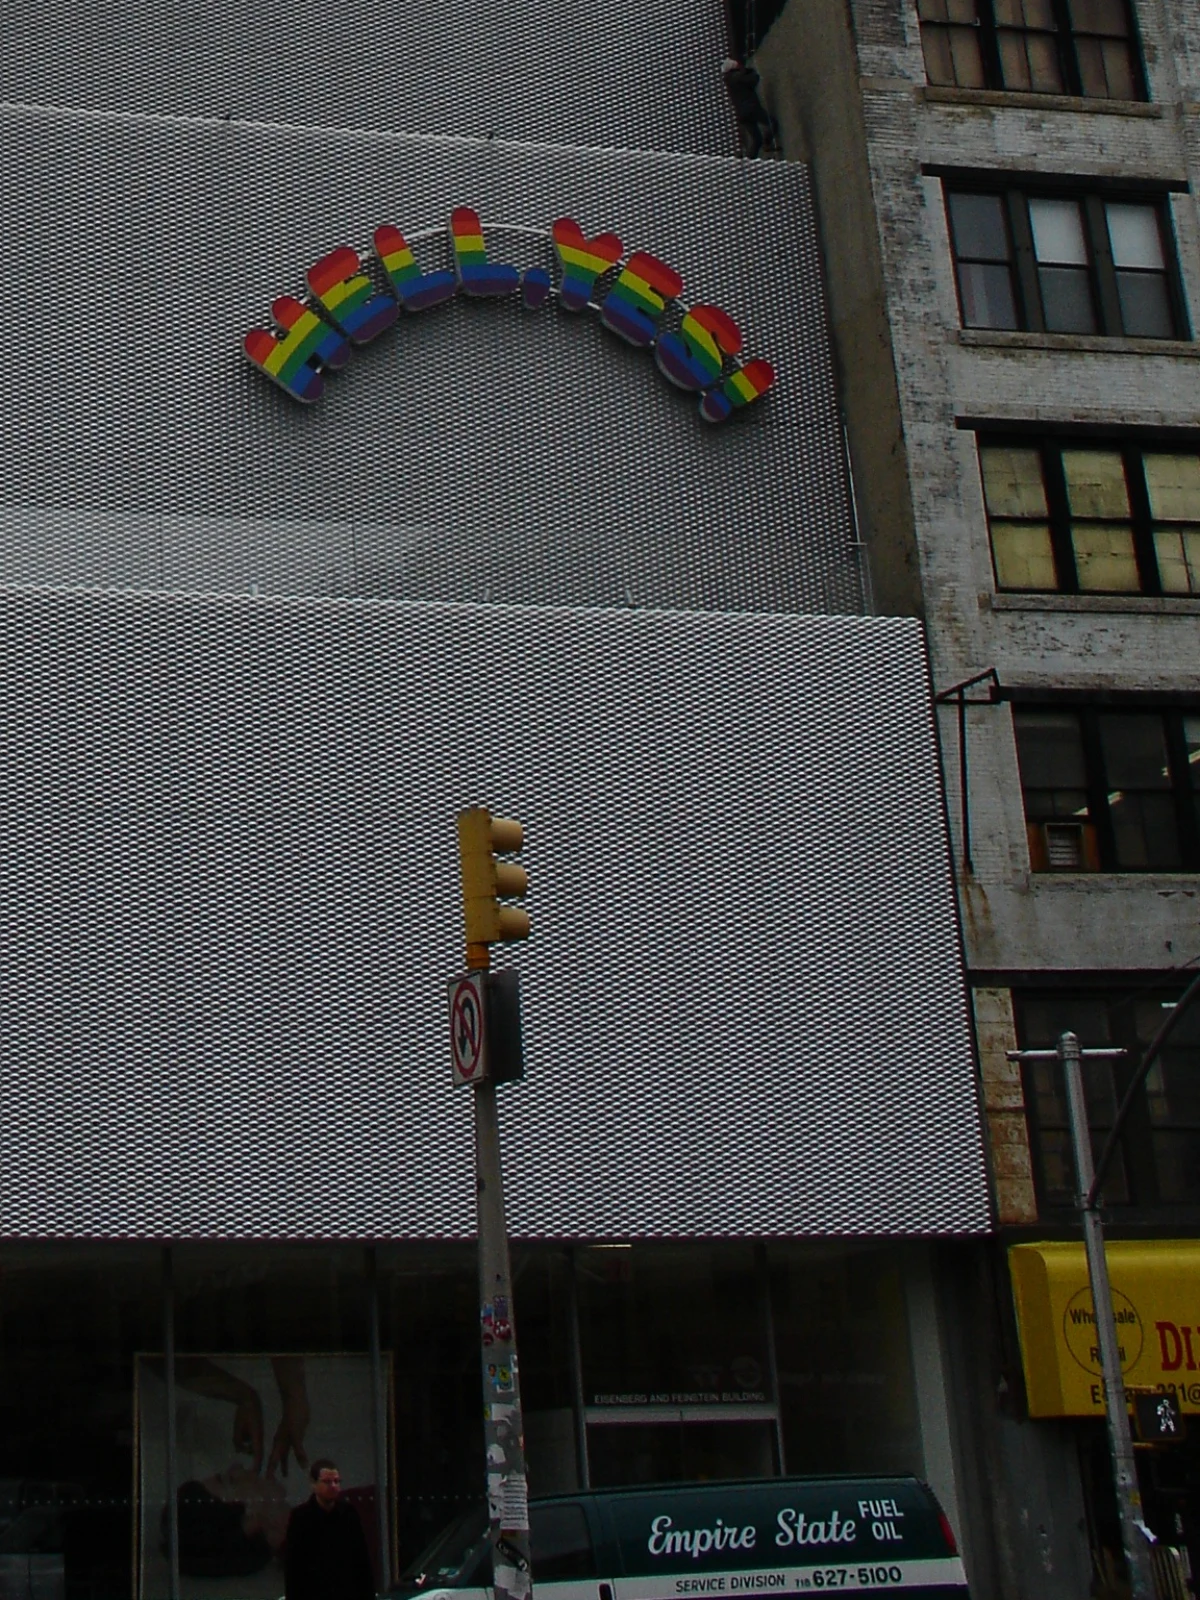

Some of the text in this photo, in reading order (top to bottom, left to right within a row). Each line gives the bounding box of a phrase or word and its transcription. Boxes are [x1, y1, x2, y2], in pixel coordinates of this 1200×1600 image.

[650, 1393, 670, 1403] AND
[722, 1391, 765, 1402] BUILDING
[857, 1499, 904, 1519] FUEL
[648, 1508, 857, 1558] Empire State
[871, 1520, 903, 1541] OIL
[676, 1578, 725, 1593] SERVICE
[730, 1574, 785, 1590] DIVISION
[813, 1566, 902, 1588] 627-5100
